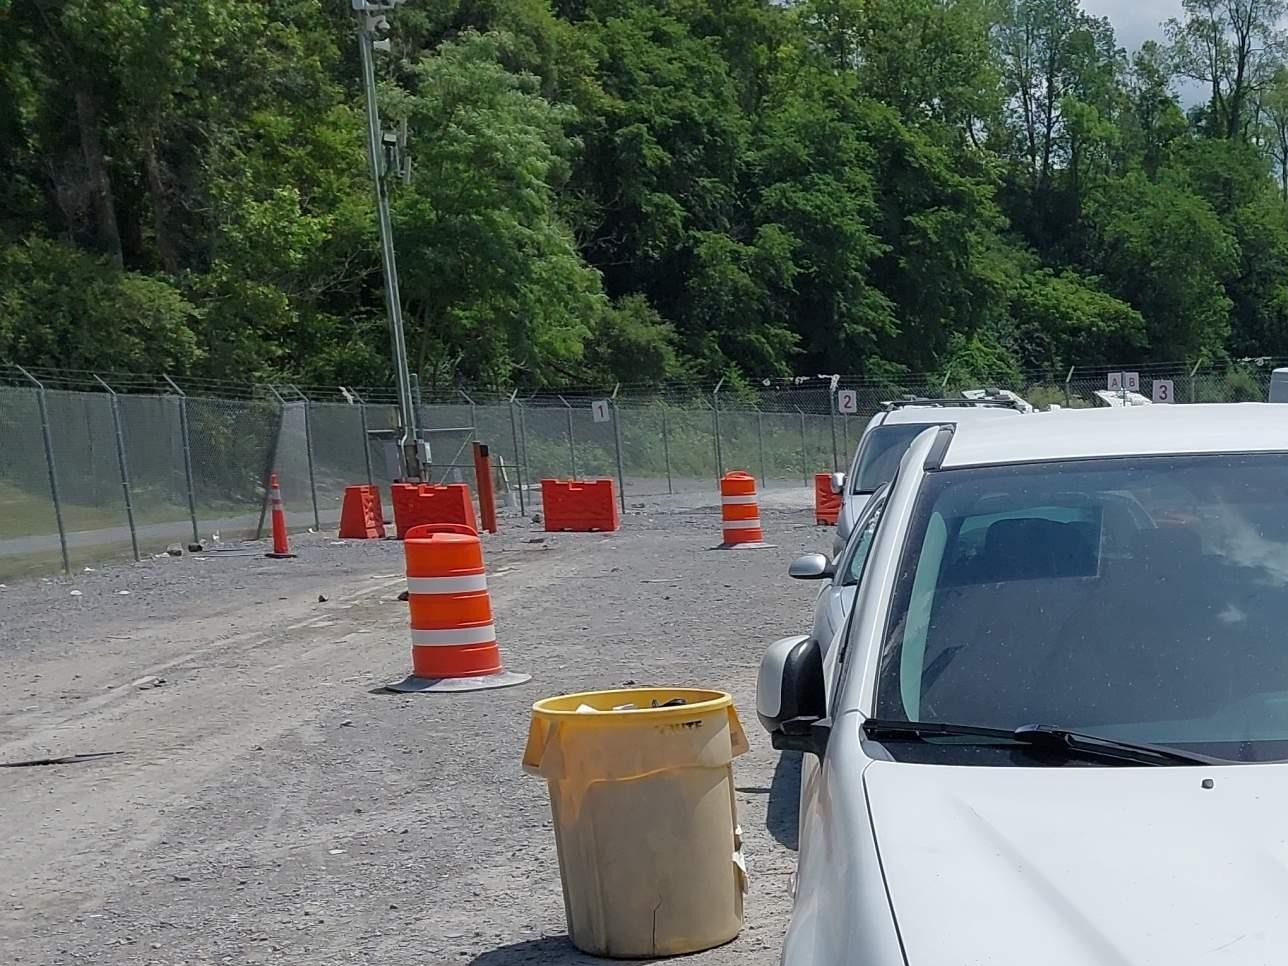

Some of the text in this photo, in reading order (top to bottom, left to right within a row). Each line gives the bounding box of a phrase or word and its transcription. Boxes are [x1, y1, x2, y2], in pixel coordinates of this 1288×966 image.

[1111, 378, 1118, 388] A
[1129, 377, 1136, 387] B
[1159, 384, 1168, 400] 3
[843, 395, 852, 409] 2
[598, 405, 604, 418] 1
